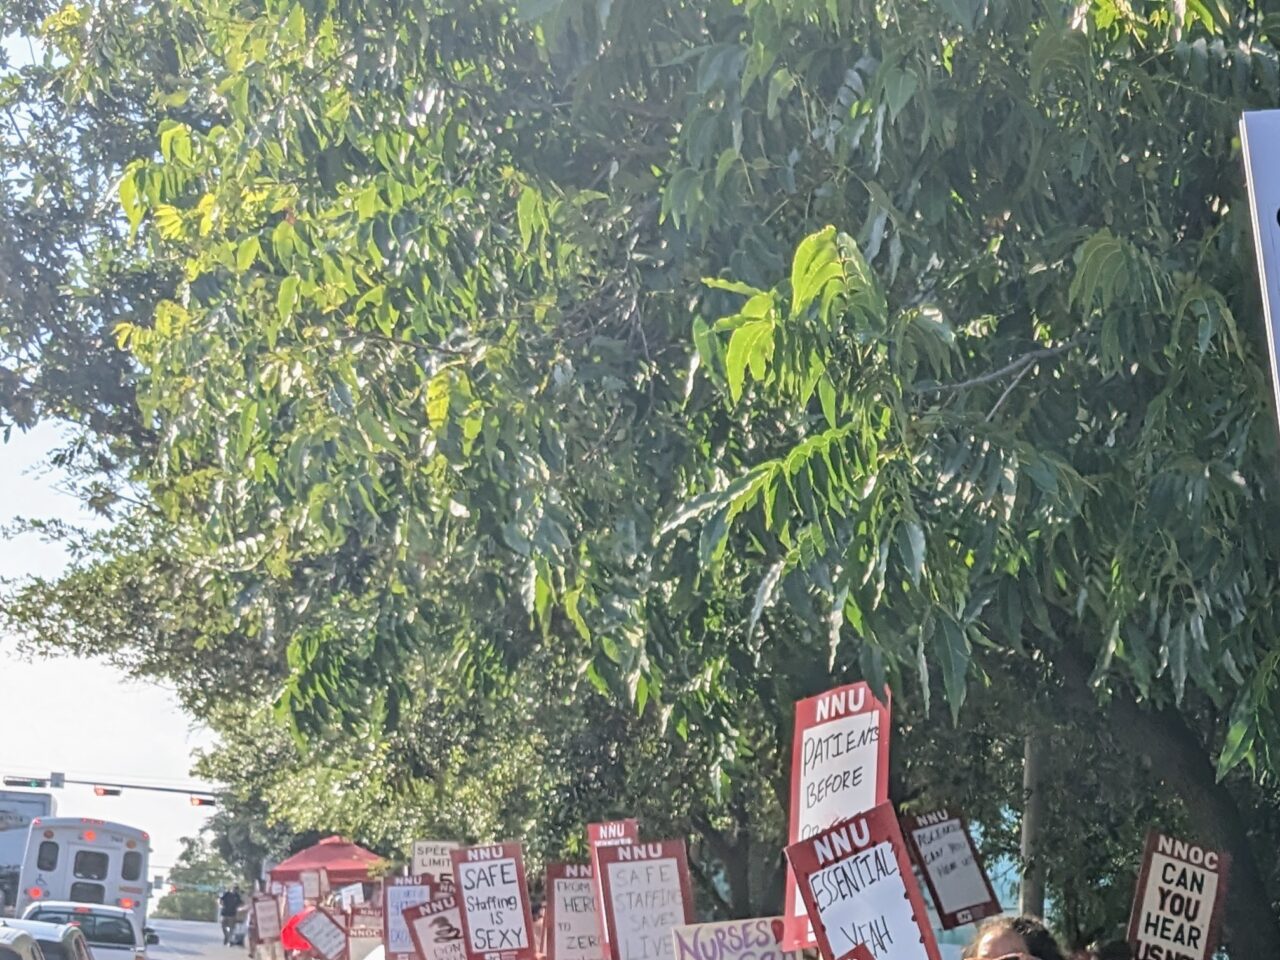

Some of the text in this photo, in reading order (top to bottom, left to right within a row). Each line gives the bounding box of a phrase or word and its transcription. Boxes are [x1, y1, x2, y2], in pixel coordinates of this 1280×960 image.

[815, 687, 866, 722] NNU
[804, 726, 880, 776] PATIENTS
[806, 766, 863, 809] BEFORE
[916, 808, 949, 826] NNU
[600, 824, 624, 839] NNU
[813, 818, 870, 865] NNU
[416, 845, 448, 856] SPEE
[467, 846, 504, 861] NNU
[618, 843, 662, 860] NNU
[1157, 834, 1219, 870] NNOC
[421, 858, 451, 868] LIMIT
[566, 864, 592, 878] NN
[395, 875, 423, 885] NNU
[464, 862, 517, 890] SAFE
[557, 881, 591, 893] FROM
[615, 863, 672, 888] SAFE
[810, 847, 897, 913] ESSENTIAL
[1161, 862, 1205, 894] CAN
[418, 896, 455, 917] NNU
[467, 895, 517, 913] Staffing
[615, 890, 683, 913] STAFFING
[1158, 886, 1201, 922] YOU
[490, 911, 504, 926] IS
[631, 911, 677, 932] SAVES
[474, 927, 523, 950] SEXY
[840, 915, 893, 958] YEAH
[1144, 911, 1202, 950] HEAR
